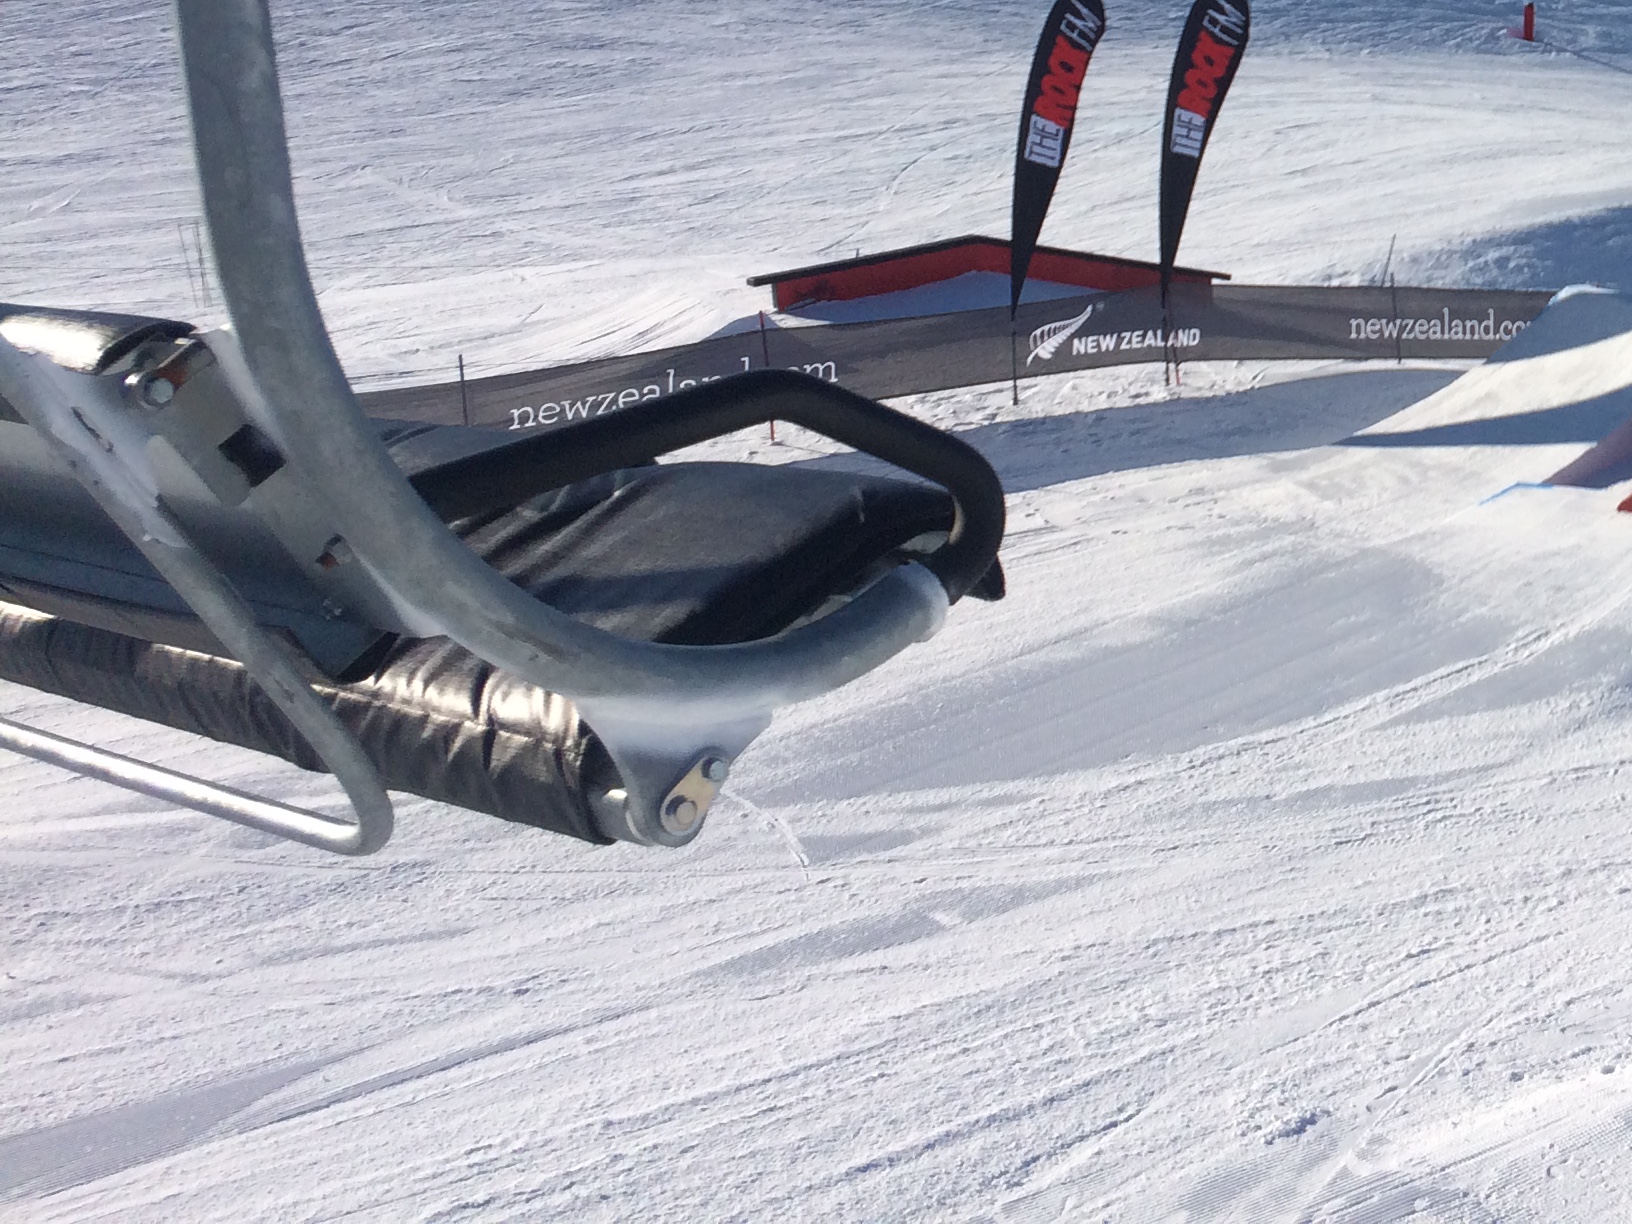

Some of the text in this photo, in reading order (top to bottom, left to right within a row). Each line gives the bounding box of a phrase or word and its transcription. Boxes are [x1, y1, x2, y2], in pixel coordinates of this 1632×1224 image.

[1028, 119, 1061, 161] THE
[1172, 112, 1206, 155] THE
[1071, 327, 1201, 356] NEW ZEALAND
[1348, 306, 1532, 341] newzealand.co
